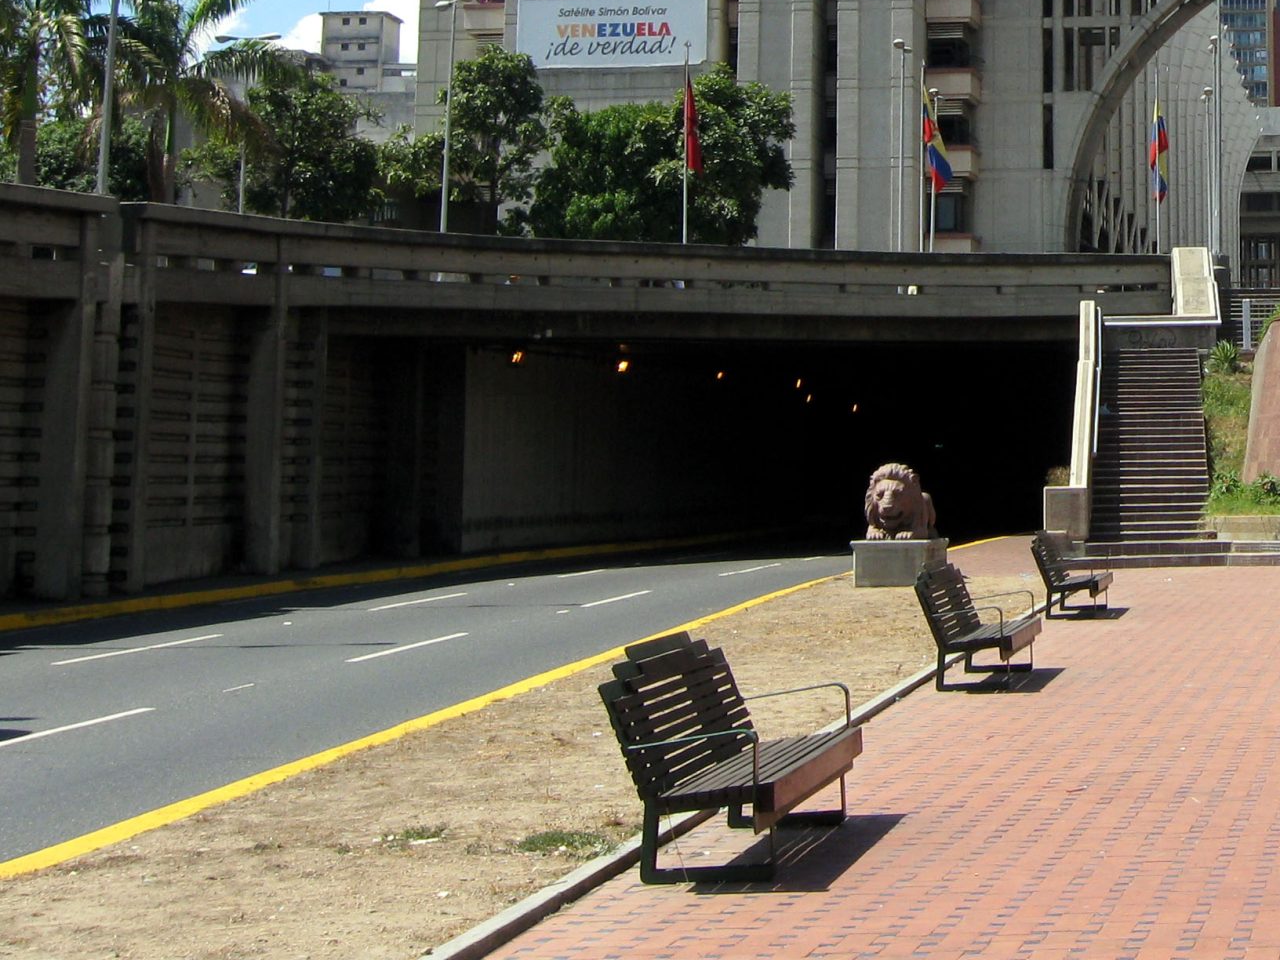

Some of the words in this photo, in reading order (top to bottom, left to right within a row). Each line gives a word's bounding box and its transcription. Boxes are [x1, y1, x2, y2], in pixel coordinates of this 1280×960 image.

[558, 7, 596, 18] Satélite
[598, 6, 630, 17] Simón
[632, 5, 668, 16] Bolívar
[556, 22, 672, 38] VENEZUELA
[545, 35, 583, 60] ¡de
[588, 33, 677, 55] verdad!
